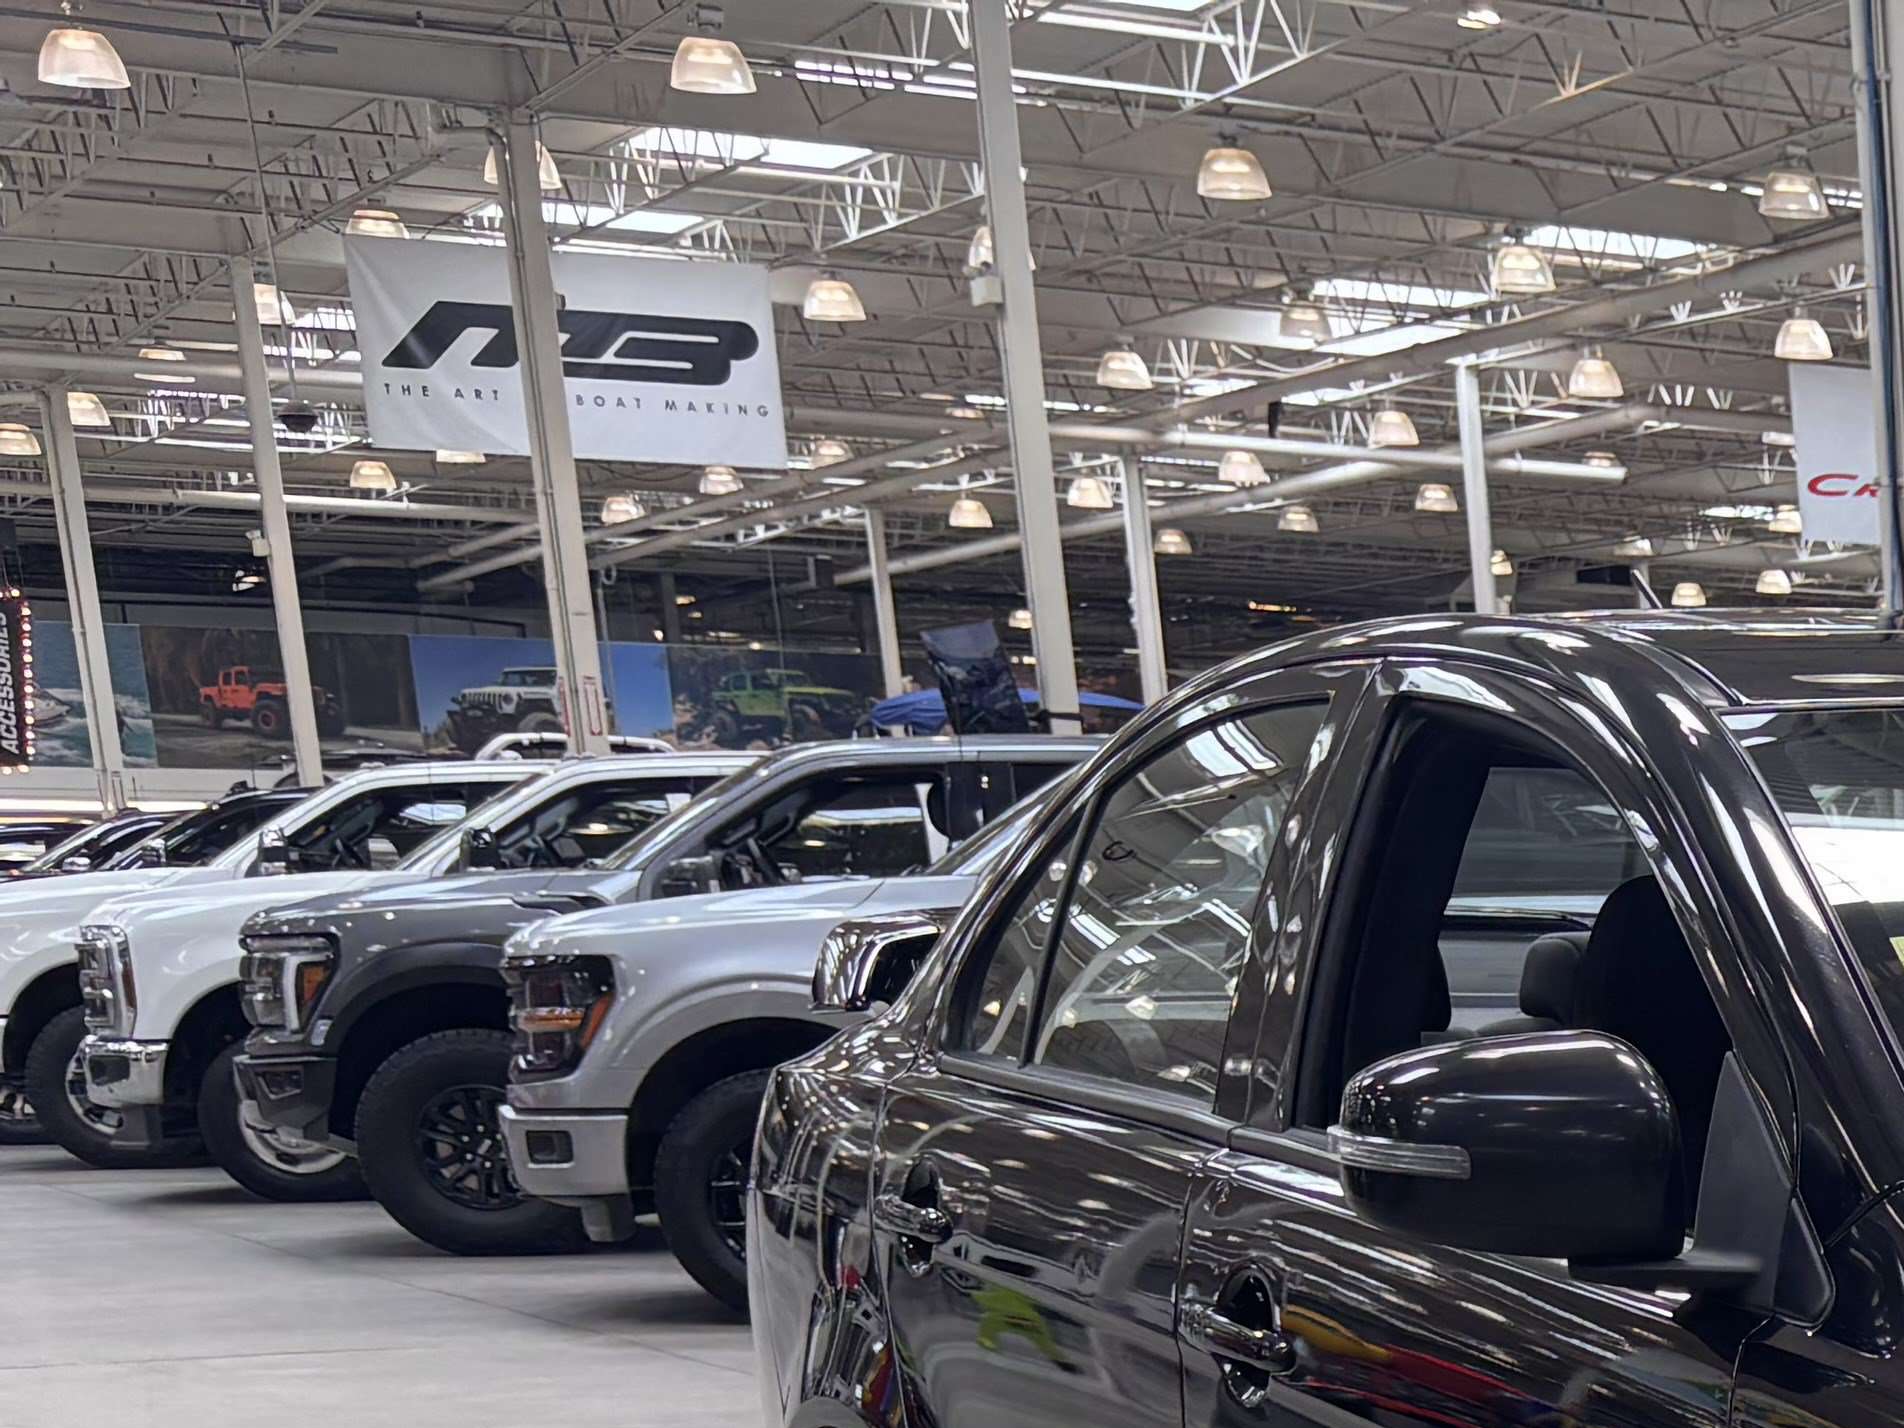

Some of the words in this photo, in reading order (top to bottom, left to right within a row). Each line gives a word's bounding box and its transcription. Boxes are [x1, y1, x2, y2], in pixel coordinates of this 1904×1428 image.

[383, 382, 430, 399] THE
[454, 388, 500, 402] ART
[575, 394, 642, 409] BOAT
[665, 399, 770, 417] MAKING
